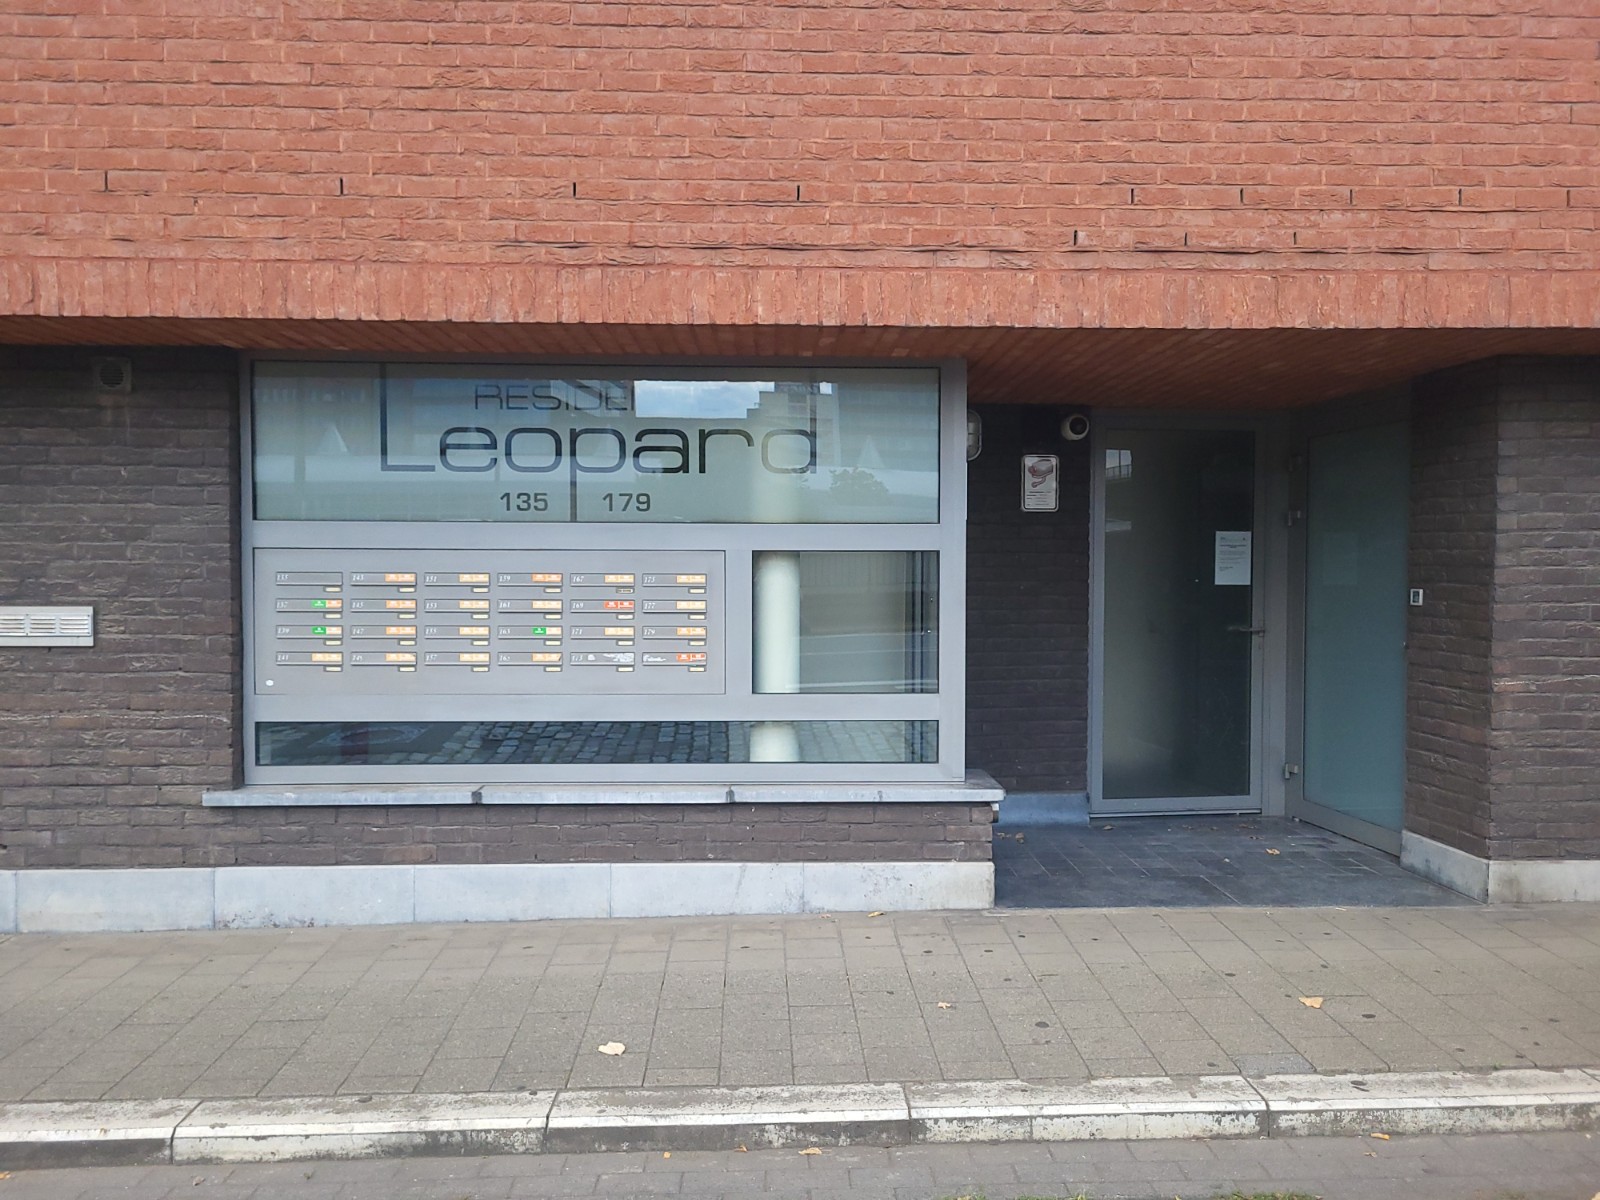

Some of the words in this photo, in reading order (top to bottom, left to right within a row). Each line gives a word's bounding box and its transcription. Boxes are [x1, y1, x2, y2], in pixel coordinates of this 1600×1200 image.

[474, 383, 635, 412] RESIDE
[379, 365, 818, 520] Leopard
[499, 492, 549, 512] 135
[602, 492, 652, 512] 179
